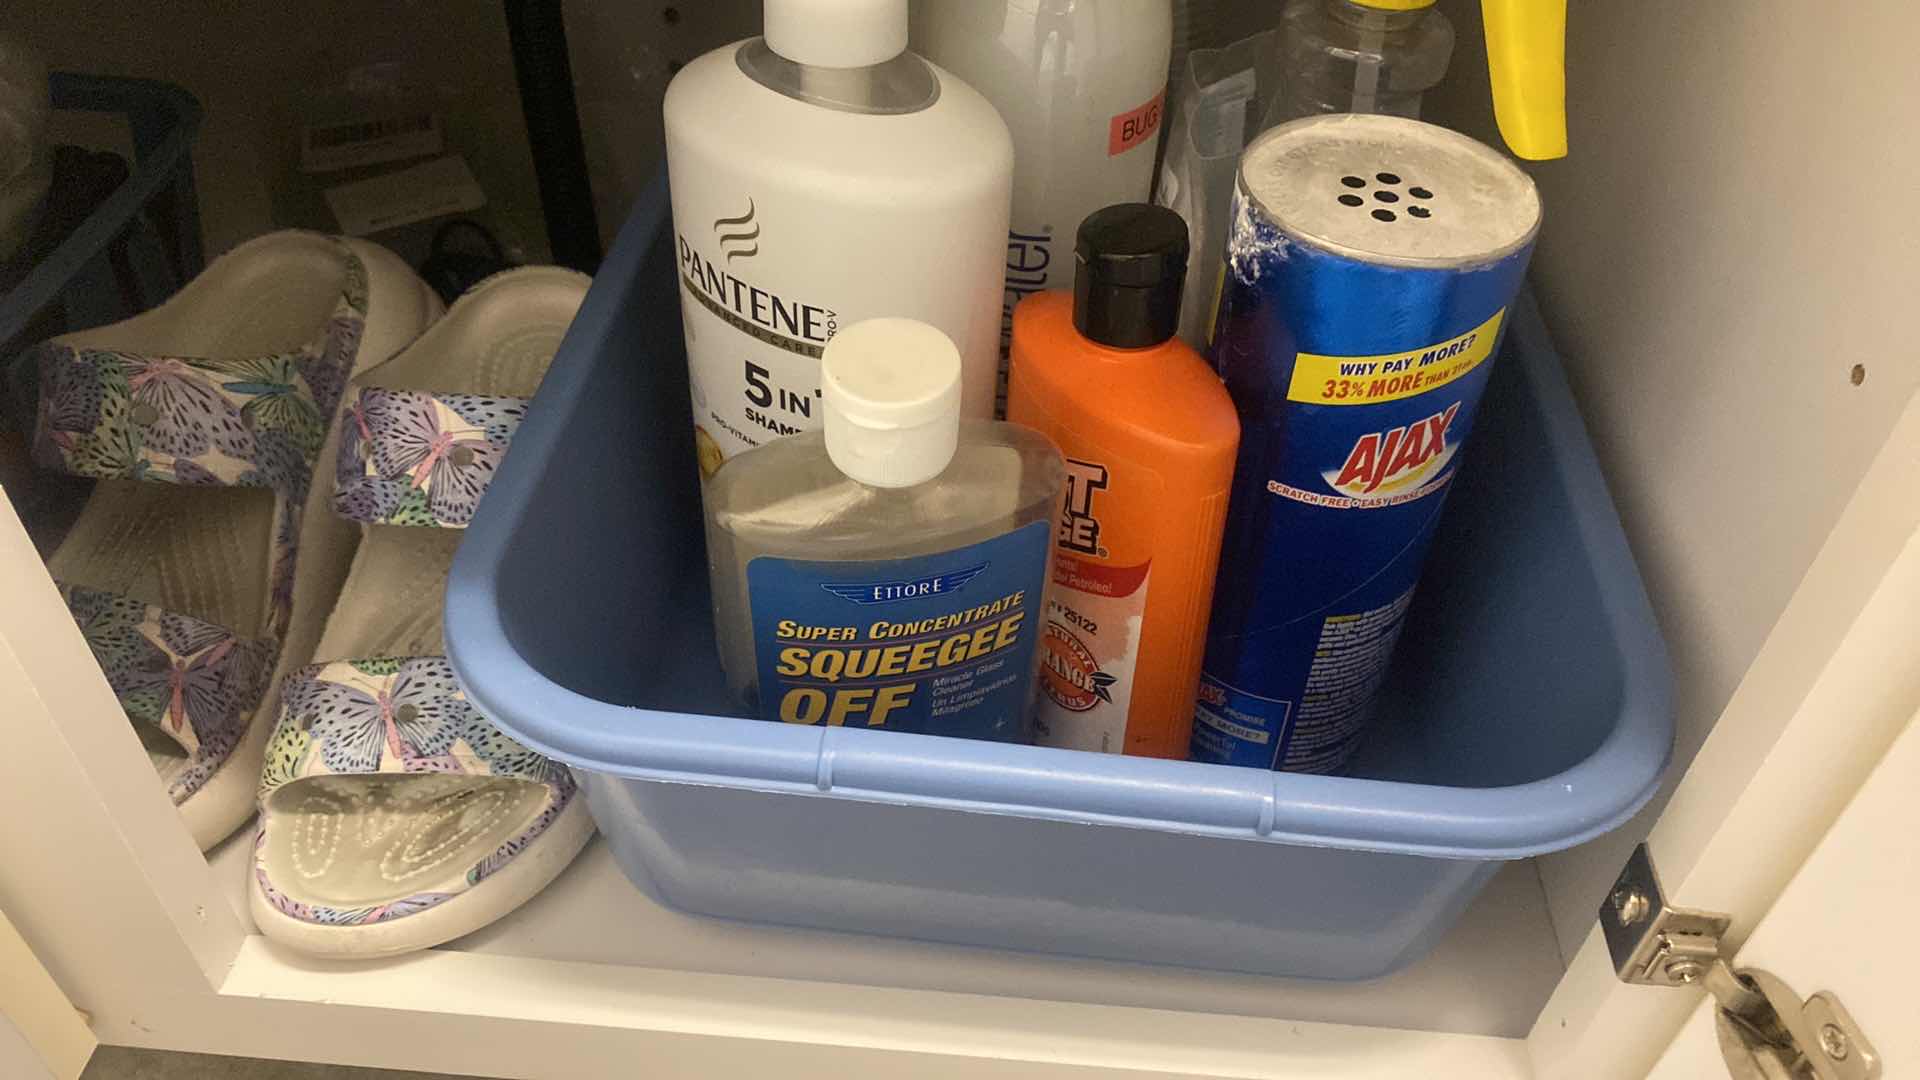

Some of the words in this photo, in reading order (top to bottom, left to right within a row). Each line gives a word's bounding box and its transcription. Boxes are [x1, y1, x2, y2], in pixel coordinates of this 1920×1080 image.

[1122, 104, 1158, 142] BUG
[679, 234, 825, 343] PANTENE
[1340, 363, 1377, 376] WHY
[1382, 357, 1413, 373] PAY
[1419, 334, 1476, 366] MORE?
[744, 359, 773, 408] 5
[779, 388, 811, 418] IN
[1322, 379, 1364, 398] 33%
[1366, 371, 1425, 398] MORE
[1425, 369, 1450, 386] THAN
[745, 407, 802, 436] SHAM
[1335, 401, 1461, 493] AJAX
[1268, 481, 1319, 503] SCRATCH
[1322, 496, 1350, 507] FREE
[1359, 496, 1391, 508] EASY
[873, 579, 942, 600] ETTORE
[776, 620, 858, 641] SUPER
[868, 590, 1025, 640] CONCENTRATE
[1064, 606, 1097, 635] 25122
[776, 612, 1026, 683] SQUEEGEE
[779, 683, 916, 727] OFF
